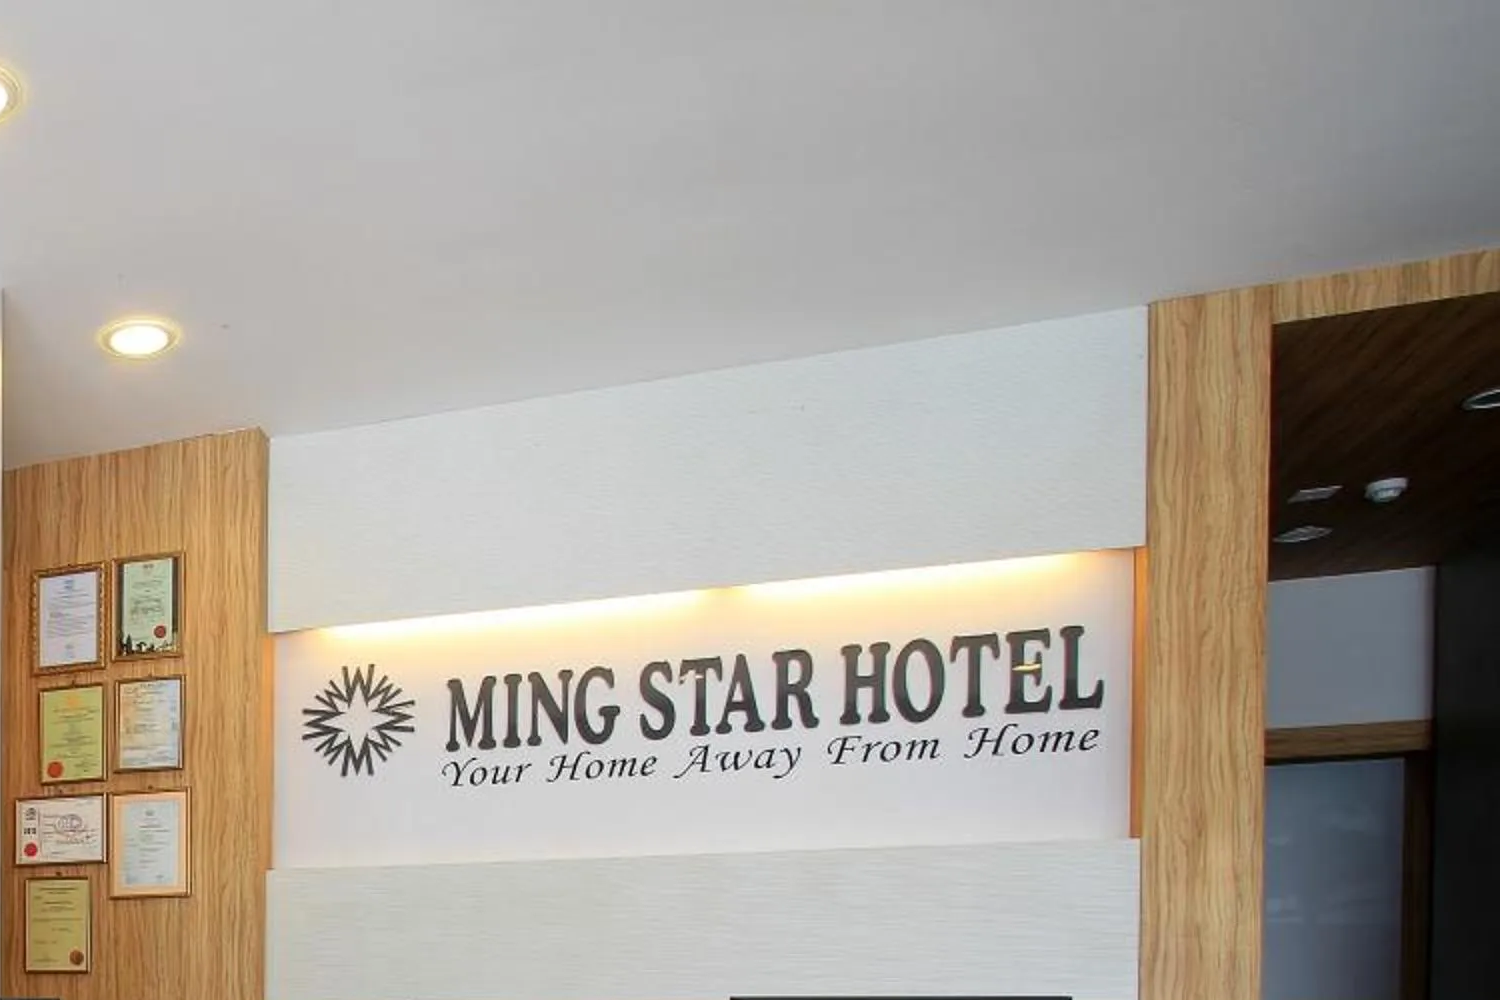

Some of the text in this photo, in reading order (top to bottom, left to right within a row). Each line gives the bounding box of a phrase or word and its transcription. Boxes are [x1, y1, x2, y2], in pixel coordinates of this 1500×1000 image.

[446, 625, 1105, 752] MING STAR HOTEL
[441, 723, 1101, 787] Your Home Away From Home
